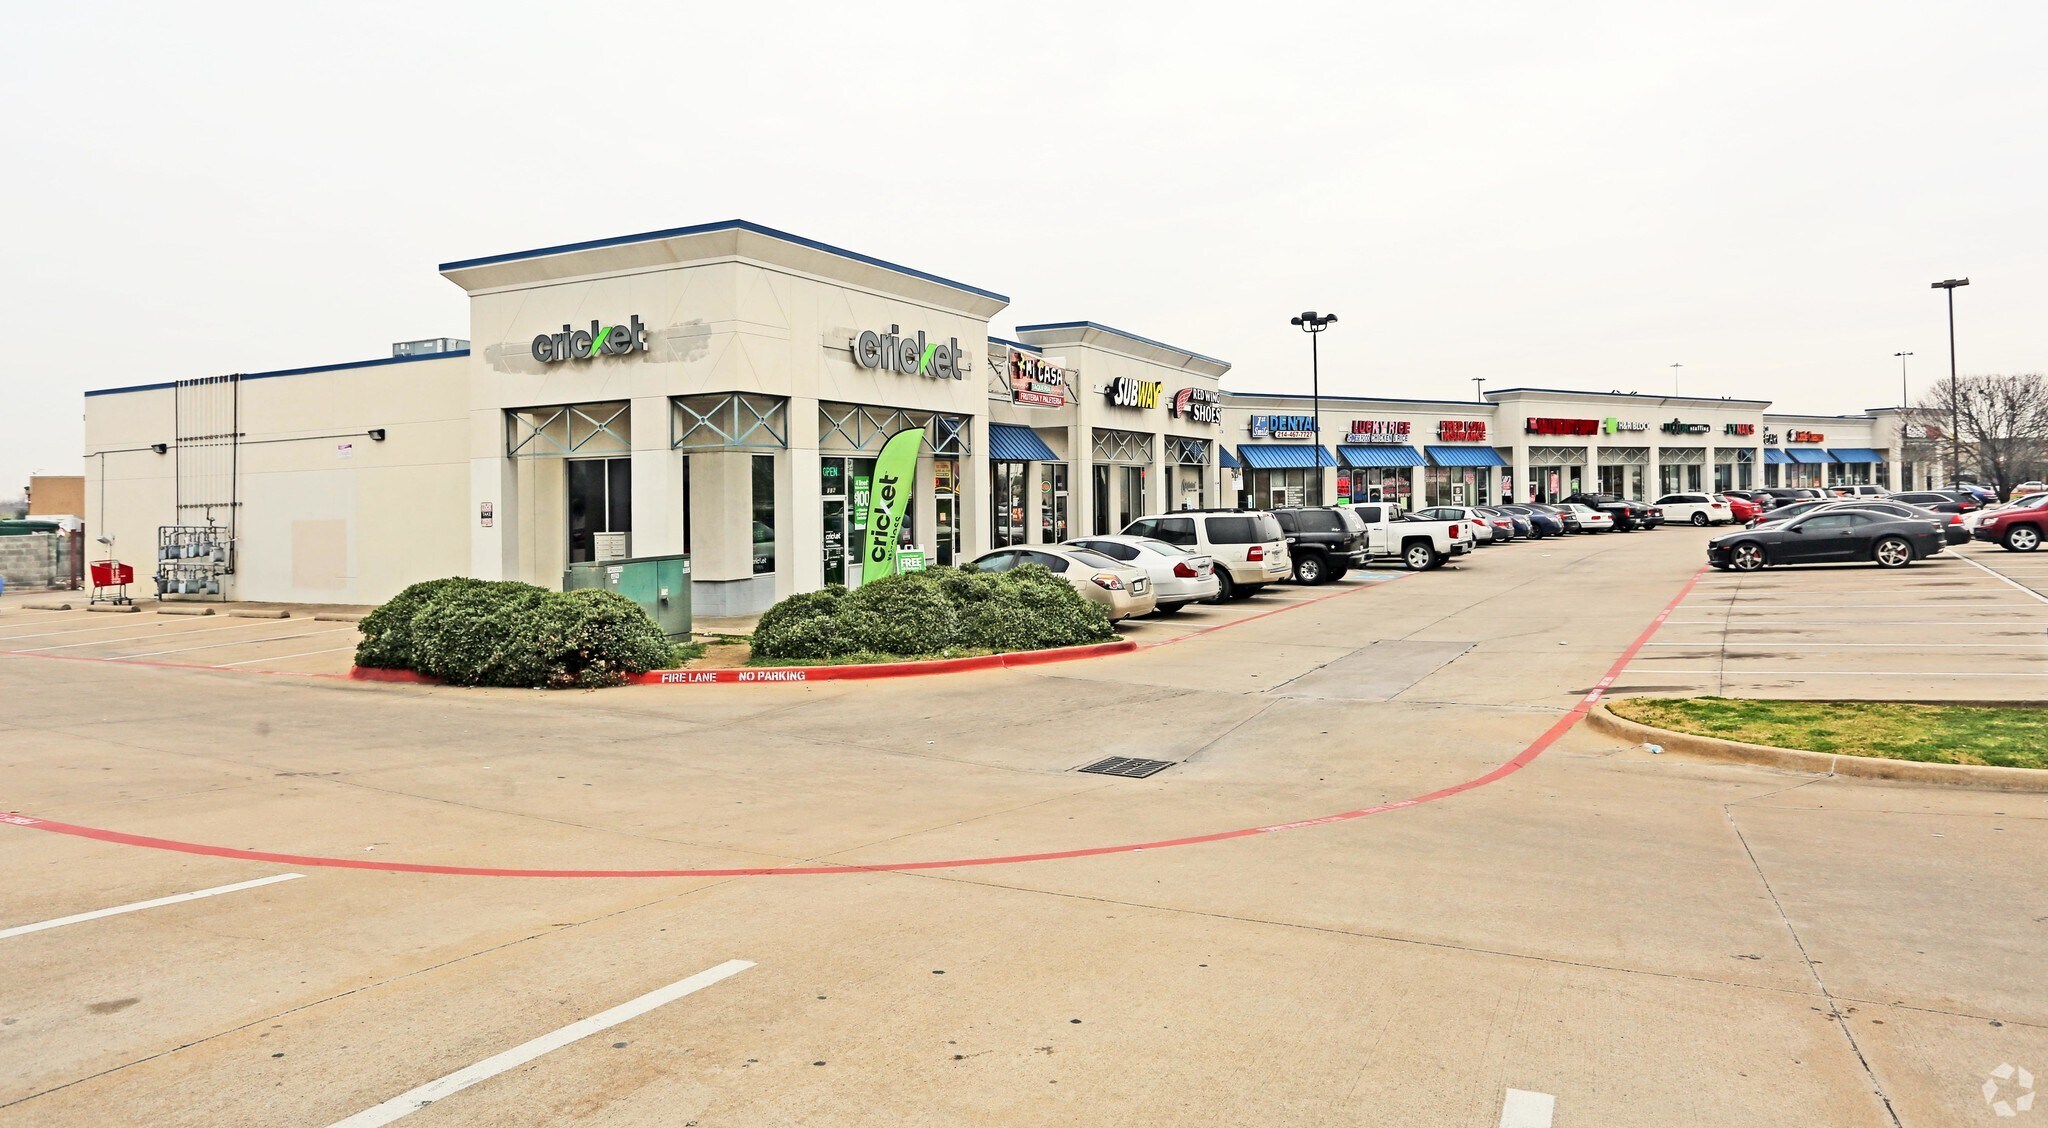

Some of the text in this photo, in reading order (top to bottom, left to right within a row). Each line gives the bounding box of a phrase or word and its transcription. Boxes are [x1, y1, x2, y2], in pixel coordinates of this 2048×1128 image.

[532, 314, 645, 362] cricket
[858, 323, 962, 380] cricket
[1038, 365, 1063, 386] CASA
[1114, 376, 1163, 409] SUBWAY
[1192, 387, 1220, 404] RED WING
[1193, 404, 1221, 423] SHOES
[1352, 420, 1410, 434] LUCKY RICE
[1617, 421, 1632, 431] H&R
[1689, 425, 1710, 433] staffing
[1371, 434, 1392, 442] CHICKEN
[1440, 431, 1487, 441] INSURANCE
[822, 466, 838, 477] OPEN
[854, 490, 870, 507] $100
[871, 472, 899, 563] cricket
[900, 557, 923, 569] FREE
[661, 672, 717, 684] FIRE LANE
[738, 670, 806, 682] NO PARKING
